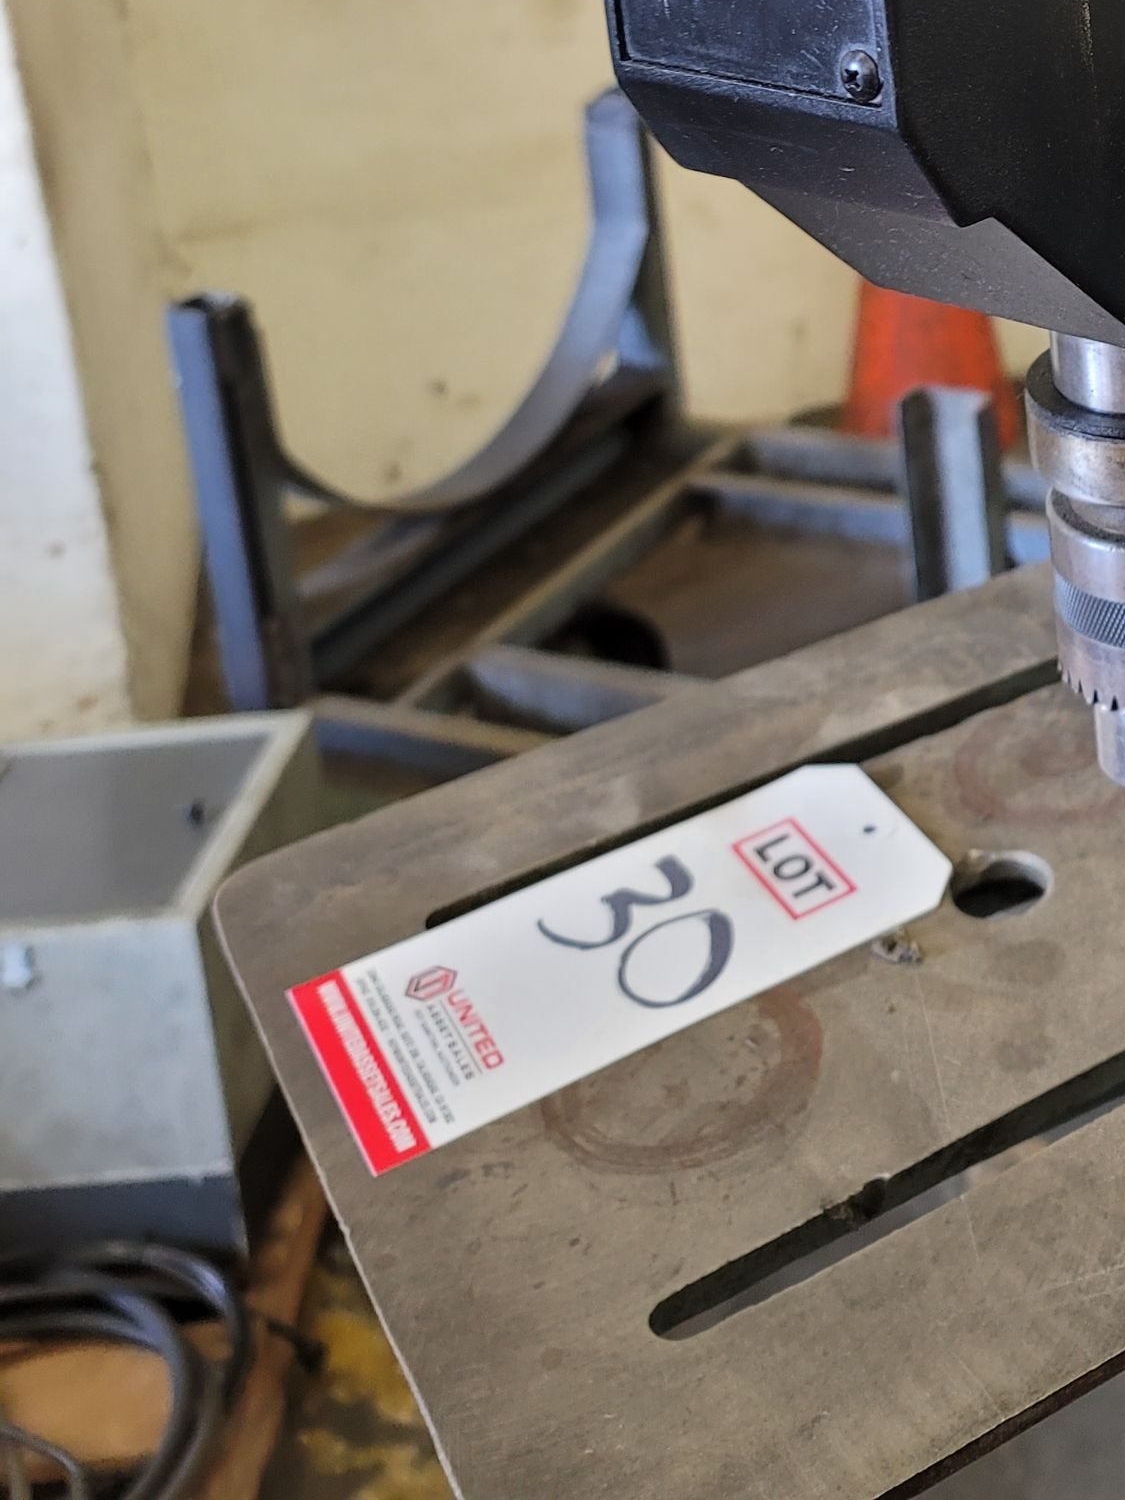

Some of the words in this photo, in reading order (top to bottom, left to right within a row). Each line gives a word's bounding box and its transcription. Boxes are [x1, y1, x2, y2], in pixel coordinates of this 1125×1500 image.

[752, 833, 836, 898] LOT
[537, 854, 734, 1008] 30
[447, 988, 505, 1071] UNITED
